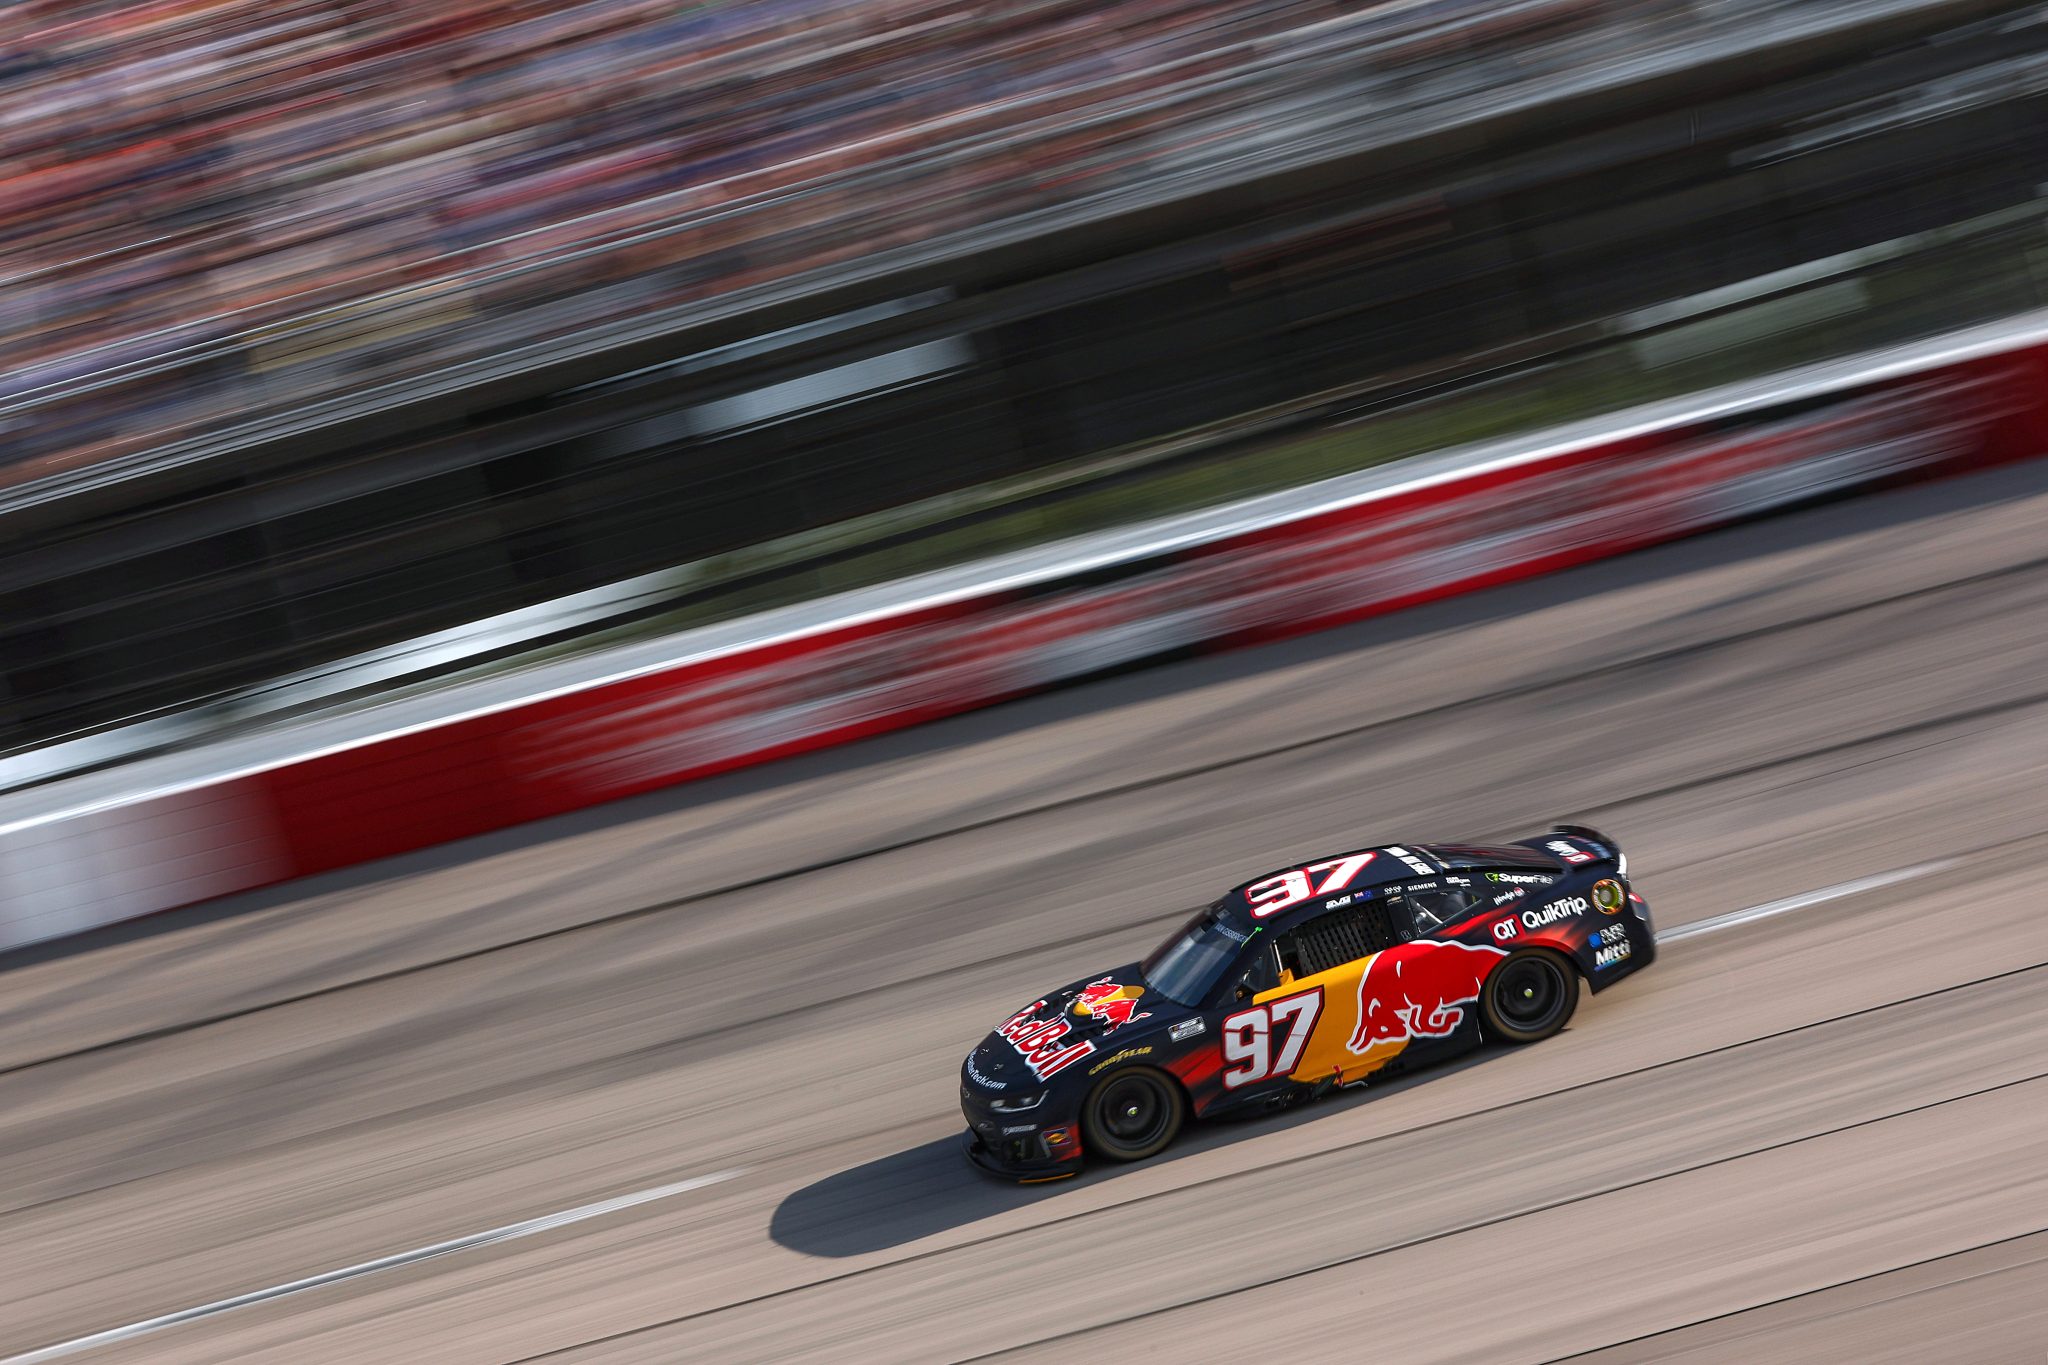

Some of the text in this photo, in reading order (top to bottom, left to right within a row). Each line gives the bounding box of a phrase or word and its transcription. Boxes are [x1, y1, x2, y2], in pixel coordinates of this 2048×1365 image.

[1244, 850, 1377, 919] 97
[1407, 881, 1438, 892] SIEMENS
[1493, 918, 1517, 940] QT
[1521, 896, 1588, 929] QuikTrip
[1221, 984, 1325, 1091] 97
